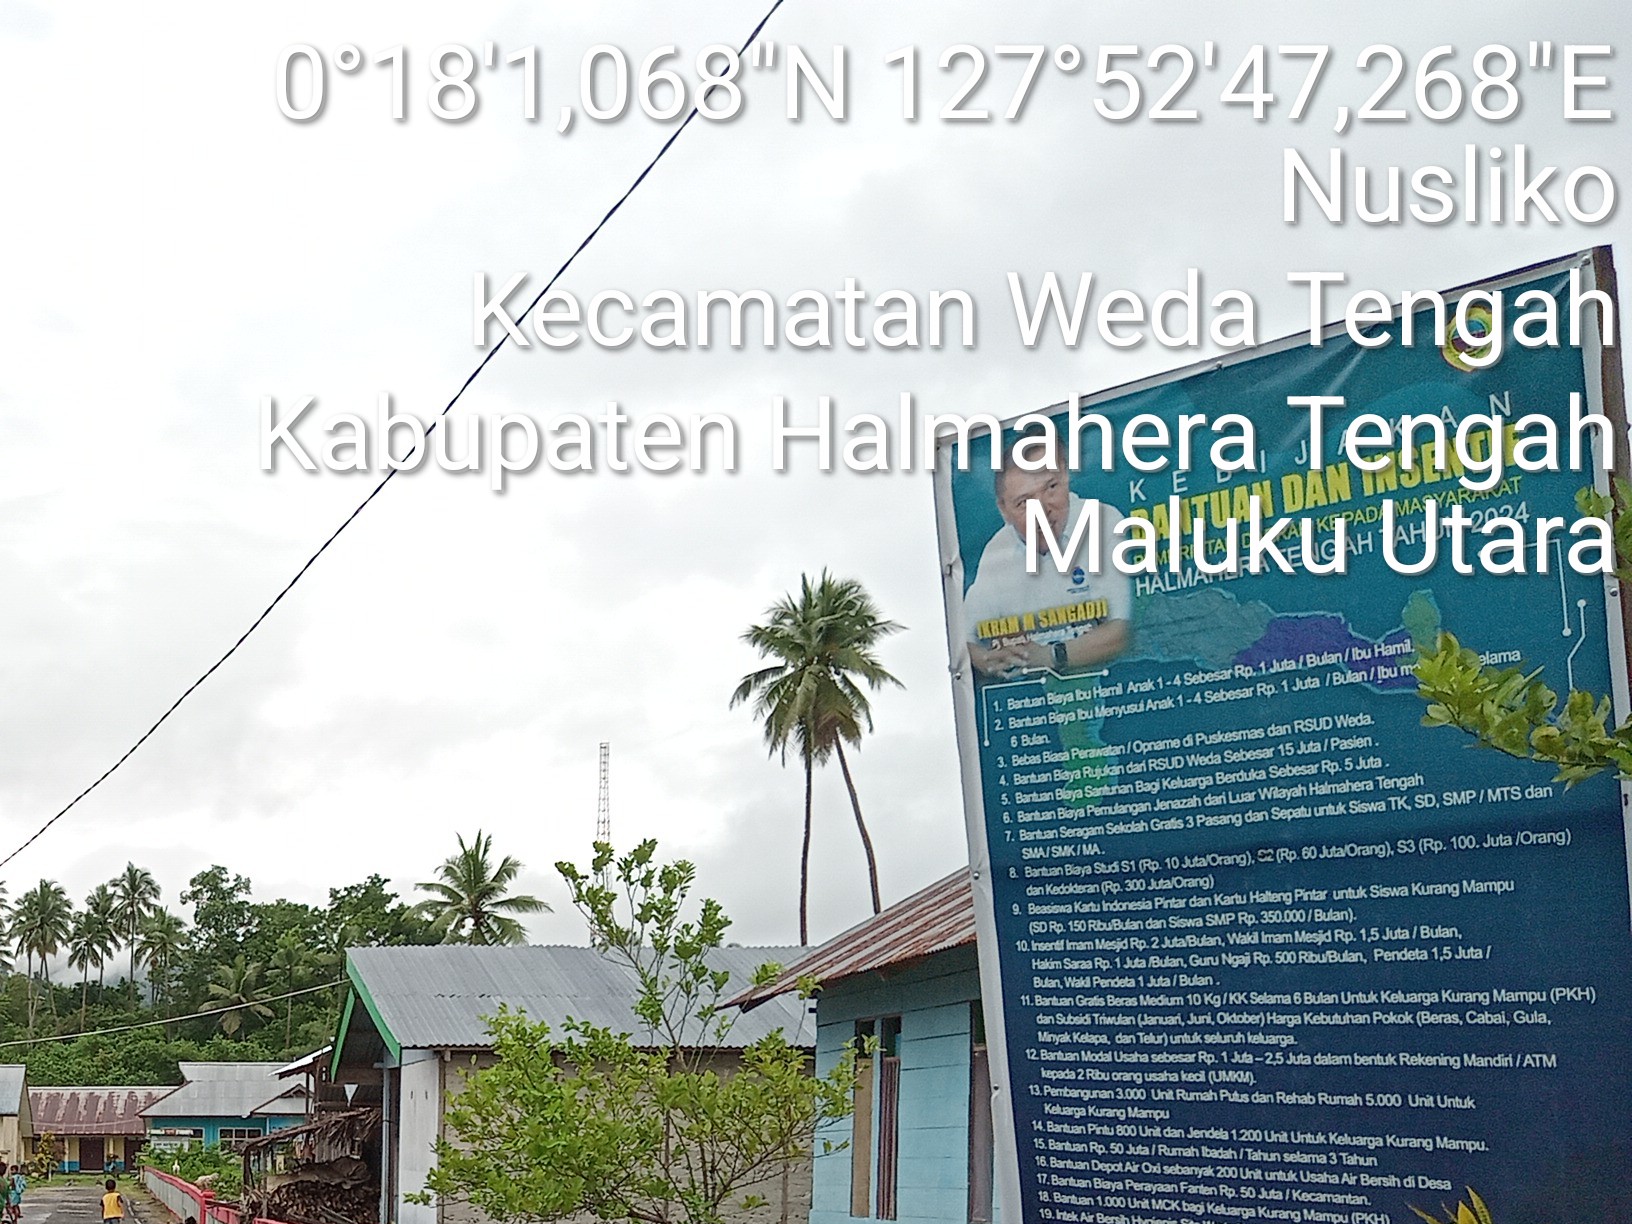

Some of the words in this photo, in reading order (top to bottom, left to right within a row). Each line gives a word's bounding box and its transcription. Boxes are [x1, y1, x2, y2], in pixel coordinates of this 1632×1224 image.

[1281, 461, 1352, 514] DAN
[1183, 668, 1233, 685] Sebesar
[1268, 658, 1297, 673] Juta
[1305, 651, 1342, 668] Bulan
[1351, 647, 1372, 661] Ibu
[1373, 640, 1415, 657] Hamil.
[1203, 686, 1254, 703] Sebesar
[1291, 676, 1320, 691] Juta
[1331, 670, 1368, 685] Bulan
[1479, 650, 1521, 666] elama
[1194, 727, 1265, 745] Puskesmas
[1266, 723, 1291, 737] dan
[1293, 716, 1333, 733] RSUD
[1334, 712, 1374, 728] Weda.
[1223, 747, 1275, 763] Sebesar
[1296, 740, 1322, 754] Juta
[1329, 734, 1372, 751] Pasien
[1214, 768, 1267, 784] Berduka
[1268, 763, 1319, 778] Sebesar
[1355, 755, 1382, 770] Juta
[1203, 791, 1227, 806] dari
[1228, 791, 1256, 804] Luar
[1257, 783, 1307, 800] Wilayah
[1308, 779, 1374, 795] Halmahera
[1377, 772, 1424, 791] Tengah
[1149, 817, 1184, 831] Gratis
[1195, 813, 1243, 827] Pasang
[1244, 809, 1269, 823] dan
[1270, 805, 1312, 821] Sepatu
[1313, 801, 1347, 817] untuk
[1348, 799, 1386, 814] Siswa
[1442, 789, 1476, 806] SMP
[1487, 785, 1522, 802] MTS
[1524, 784, 1553, 799] dan
[1450, 834, 1479, 849] 100.
[1482, 833, 1513, 848] Juta
[1213, 892, 1247, 905] Kartu
[1248, 889, 1292, 905] Halteng
[1293, 888, 1328, 901] Pintar
[1332, 885, 1368, 900] untuk
[1369, 884, 1409, 898] Siswa
[1410, 882, 1460, 897] Kurang
[1461, 879, 1514, 895] Mampu
[1168, 915, 1203, 928] Siswa
[1205, 912, 1235, 926] SMP
[1260, 909, 1306, 923] 350.000
[1313, 907, 1357, 923] Bulan).
[1226, 931, 1259, 945] Wakil
[1260, 930, 1293, 943] Imam
[1293, 929, 1332, 945] Mesjid
[1381, 926, 1410, 940] Juta
[1419, 924, 1462, 939] Bulan,
[1220, 951, 1251, 968] Ngaji
[1274, 950, 1297, 964] 500
[1373, 947, 1428, 961] Pendeta
[1454, 945, 1483, 959] Juta
[1178, 973, 1213, 986] Bulan
[1249, 991, 1292, 1004] Selama
[1303, 991, 1339, 1004] Bulan
[1340, 990, 1379, 1004] Untuk
[1379, 989, 1439, 1006] Keluarga
[1441, 989, 1490, 1005] Kurang
[1492, 988, 1547, 1005] Mampu
[1549, 986, 1596, 1004] (PKH)
[1216, 1011, 1265, 1027] Oktober)
[1265, 1011, 1302, 1027] Harga
[1302, 1011, 1371, 1025] Kebutuhan
[1372, 1011, 1414, 1024] Pokok
[1415, 1010, 1463, 1027] (Beras,
[1465, 1010, 1510, 1026] Cabai,
[1512, 1010, 1551, 1025] Gula,
[1169, 1031, 1203, 1044] untuk
[1203, 1031, 1246, 1044] seluruh
[1246, 1031, 1298, 1047] keluarga.
[1230, 1050, 1253, 1063] Juta
[1285, 1052, 1312, 1065] Juta
[1312, 1052, 1352, 1065] dalam
[1353, 1052, 1397, 1066] bentuk
[1398, 1052, 1461, 1069] Rekening
[1462, 1053, 1513, 1067] Mandiri
[1522, 1053, 1557, 1067] ATM
[1180, 1069, 1206, 1082] kecil
[1275, 1091, 1316, 1105] Rehab
[1317, 1092, 1363, 1106] Rumah
[1365, 1093, 1402, 1107] 5.000
[1407, 1093, 1435, 1107] Unit
[1436, 1094, 1476, 1109] Untuk
[1263, 1129, 1289, 1143] Unit
[1290, 1130, 1327, 1144] Untuk
[1327, 1131, 1384, 1149] Keluarga
[1385, 1134, 1433, 1151] Kurang
[1435, 1135, 1489, 1153] Mampu.
[1244, 1147, 1281, 1162] Tahun
[1282, 1150, 1327, 1164] selama
[1338, 1152, 1378, 1166] Tahun
[1239, 1167, 1263, 1180] Unit
[1264, 1169, 1298, 1182] untuk
[1299, 1169, 1340, 1184] Usaha
[1340, 1172, 1358, 1185] Air
[1359, 1173, 1401, 1187] Bersih
[1417, 1175, 1452, 1190] Desa
[1257, 1187, 1283, 1200] Juta
[1257, 1205, 1301, 1223] Kurang
[1302, 1208, 1349, 1224] Mampu
